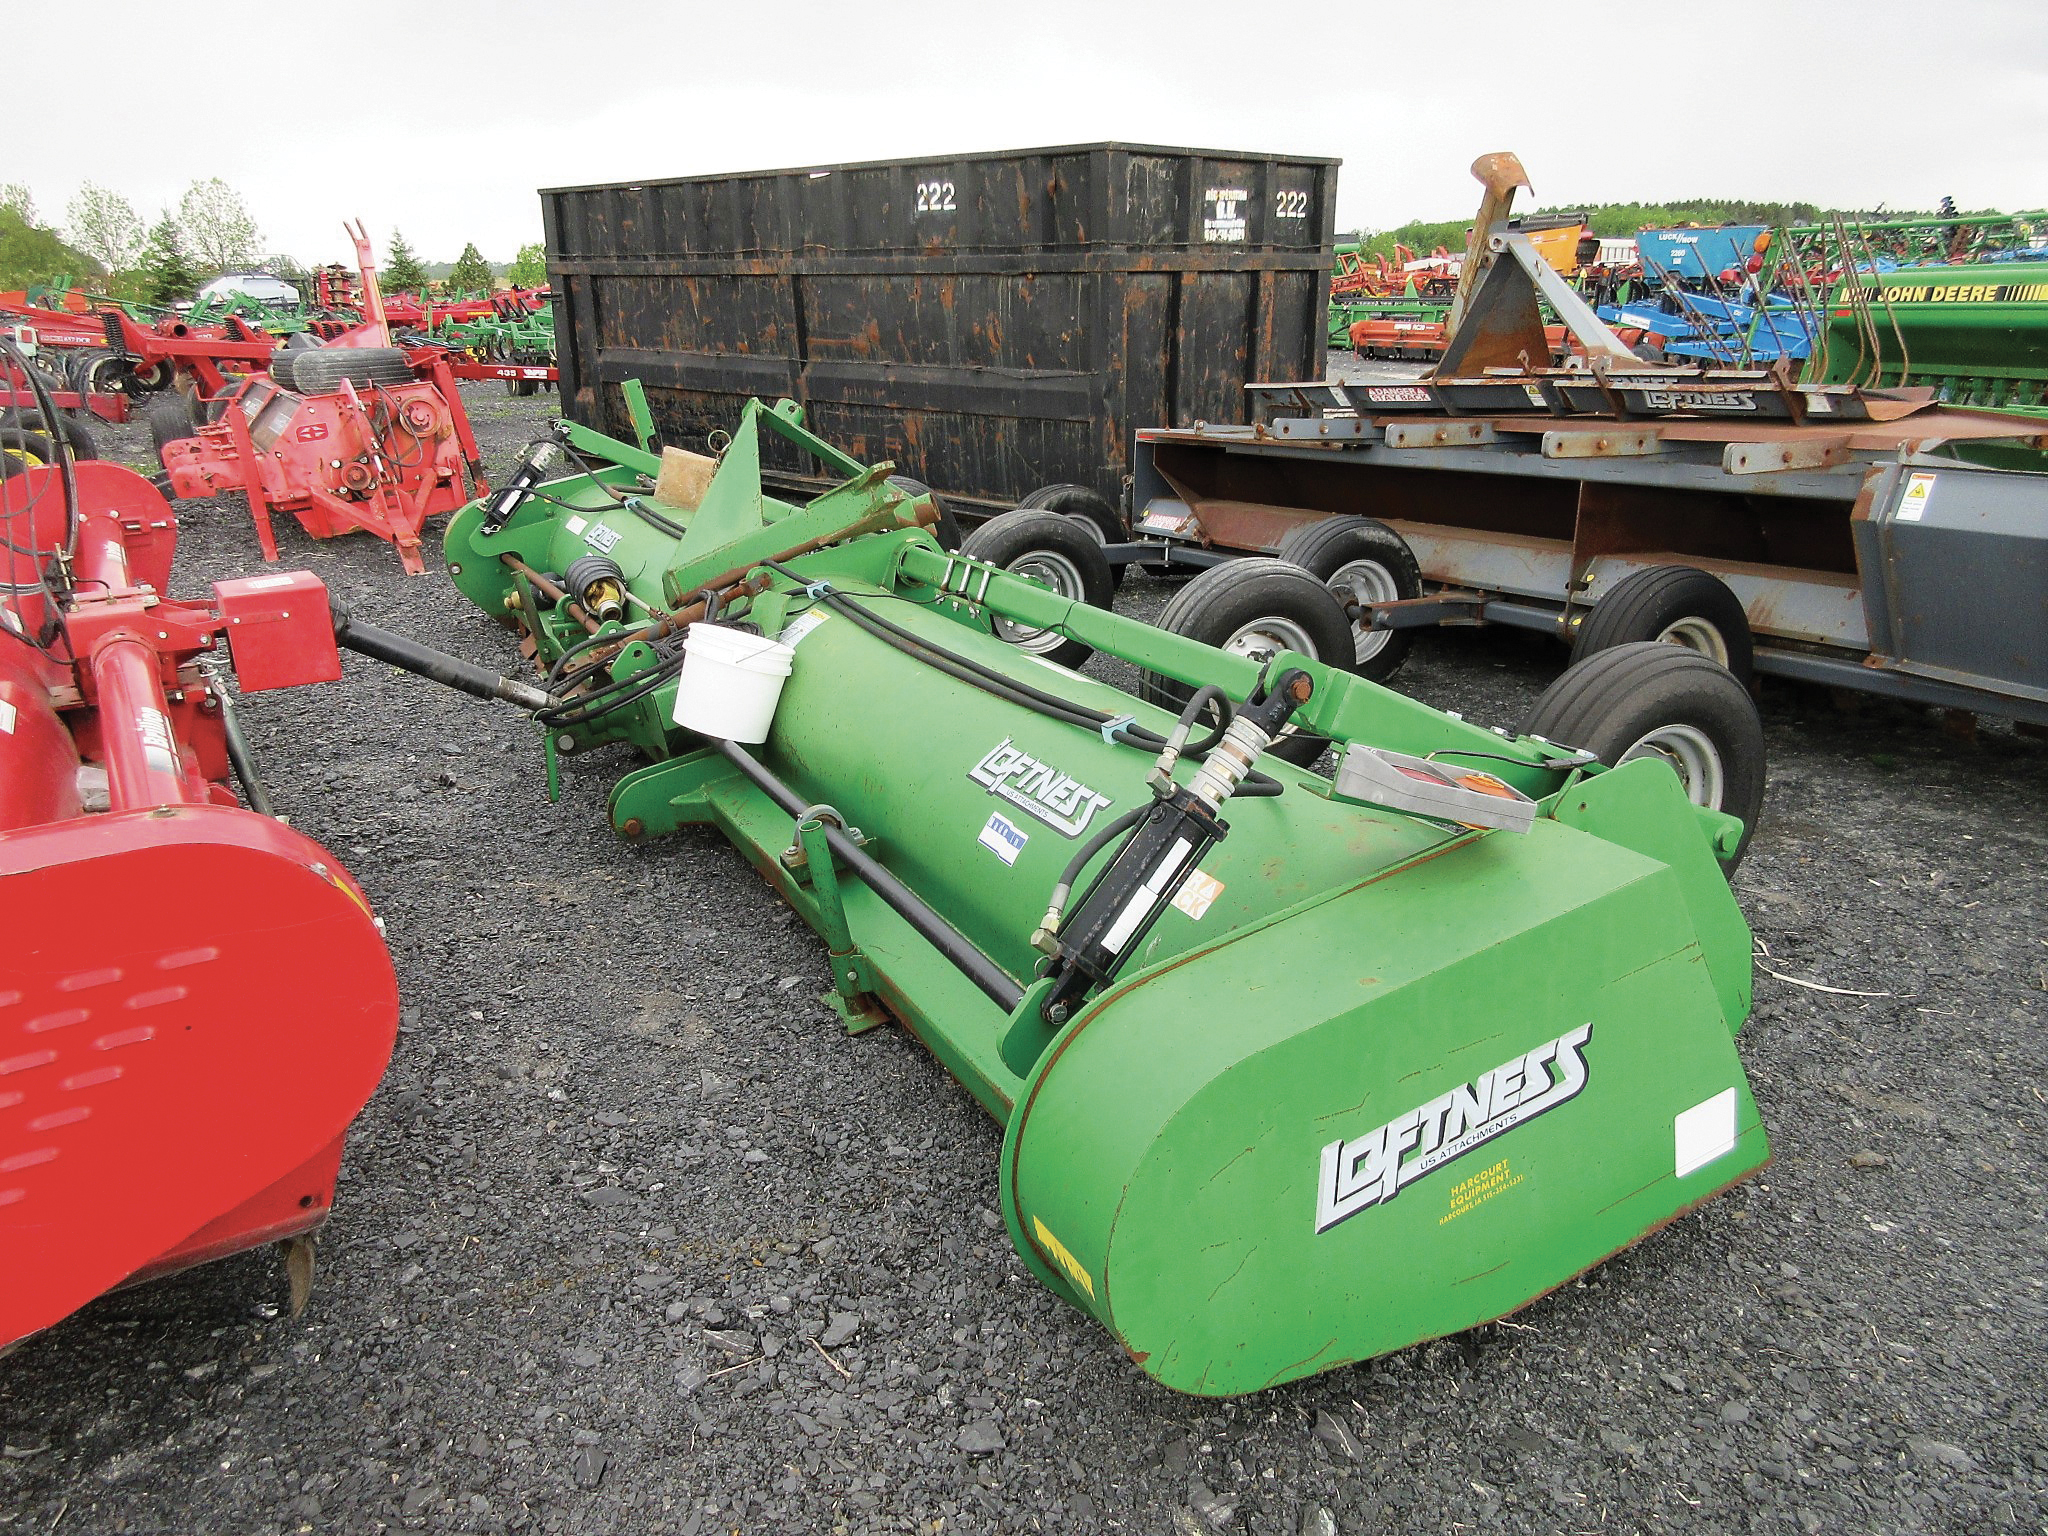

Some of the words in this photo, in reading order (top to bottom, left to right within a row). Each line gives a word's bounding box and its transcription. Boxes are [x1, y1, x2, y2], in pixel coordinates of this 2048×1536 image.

[917, 182, 956, 211] 222
[1276, 190, 1307, 218] 222
[1878, 286, 1928, 302] JOHN
[1930, 285, 2000, 302] DEERE
[496, 369, 517, 377] 435
[1375, 387, 1416, 395] DANGER
[1646, 390, 1758, 411] LOFTNESS
[966, 734, 1116, 841] LOFTNESS
[1006, 788, 1017, 799] US
[1013, 792, 1050, 819] ATTACHMENTS
[1314, 1021, 1594, 1235] LOFTNESS
[1419, 1156, 1437, 1171] US
[1438, 1113, 1518, 1160] ATTACHMENTS
[1449, 1170, 1511, 1209] EQUIPMENT
[1450, 1158, 1509, 1197] HARCOURT
